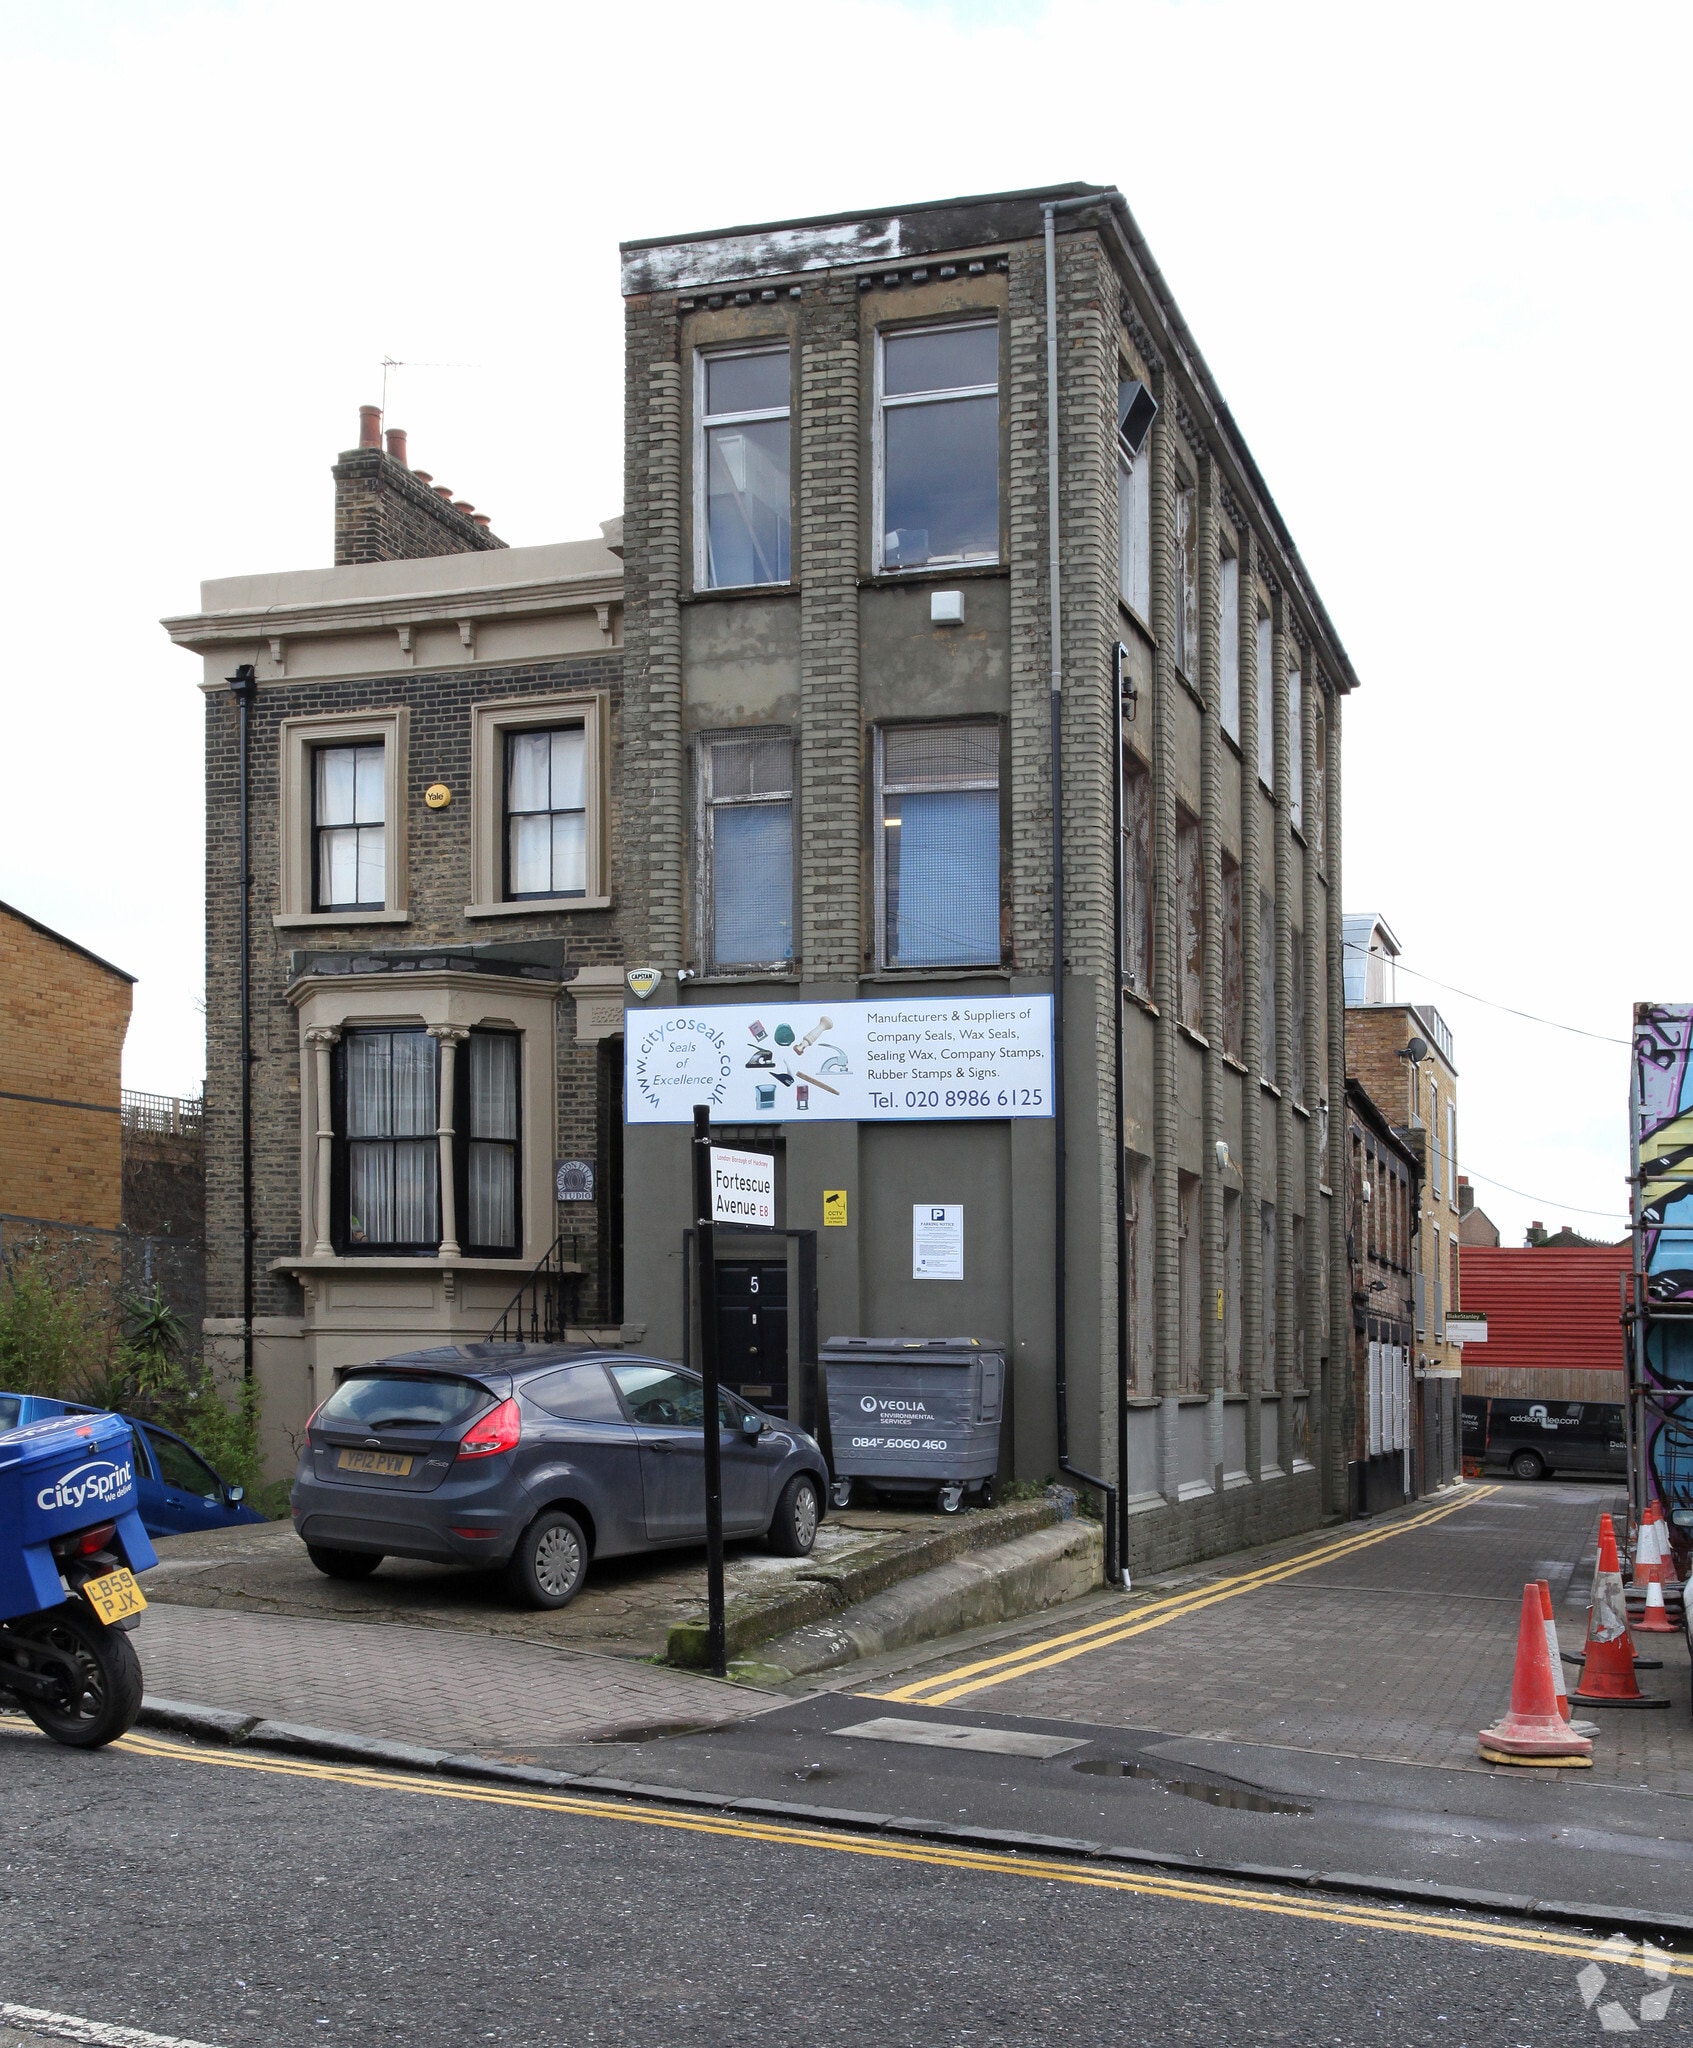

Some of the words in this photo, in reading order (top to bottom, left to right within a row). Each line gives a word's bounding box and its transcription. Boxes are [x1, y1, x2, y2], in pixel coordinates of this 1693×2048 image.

[428, 792, 443, 800] Yale
[867, 1012, 948, 1023] Manufacturers
[951, 1010, 960, 1021] &
[963, 1009, 1016, 1023] Suppliers
[1019, 1008, 1032, 1019] of
[867, 1031, 921, 1044] Company
[924, 1030, 956, 1041] Seals,
[959, 1029, 985, 1040] Wax
[988, 1028, 1020, 1040] Seals,
[668, 1042, 696, 1053] Seals
[867, 1050, 906, 1063] Sealing
[908, 1049, 937, 1061] Wax,
[940, 1048, 996, 1061] Company
[999, 1047, 1045, 1060] Stamps,
[636, 1018, 732, 1109] www.citycoseals.co.uk
[676, 1058, 690, 1069] of
[653, 1074, 714, 1086] Excellence
[867, 1069, 908, 1080] Rubber
[911, 1068, 952, 1081] Stamps
[955, 1067, 965, 1078] &
[968, 1067, 1000, 1081] Signs.
[868, 1092, 899, 1108] Tel.
[905, 1091, 939, 1108] 020
[945, 1090, 991, 1107] 8986
[997, 1089, 1043, 1106] 6125
[717, 1153, 731, 1162] London
[731, 1156, 748, 1165] Borough
[753, 1159, 768, 1168] Hackney
[557, 1162, 577, 1191] LONDON
[716, 1170, 770, 1193] Fortescue
[558, 1192, 591, 1200] STUDIO
[716, 1194, 756, 1216] Avenue
[759, 1205, 769, 1217] E8
[933, 1209, 943, 1220] P
[750, 1276, 759, 1293] 5
[879, 1400, 926, 1411] VEOLIA
[880, 1412, 935, 1420] ENVIRONMENTAL
[887, 1438, 920, 1449] 6060
[922, 1440, 947, 1450] 460
[349, 1452, 373, 1468] YP12
[37, 1461, 131, 1510] CitySprint
[104, 1492, 116, 1502] We
[117, 1483, 133, 1498] deliver
[88, 1572, 133, 1602] LB59
[102, 1591, 139, 1617] PJX
